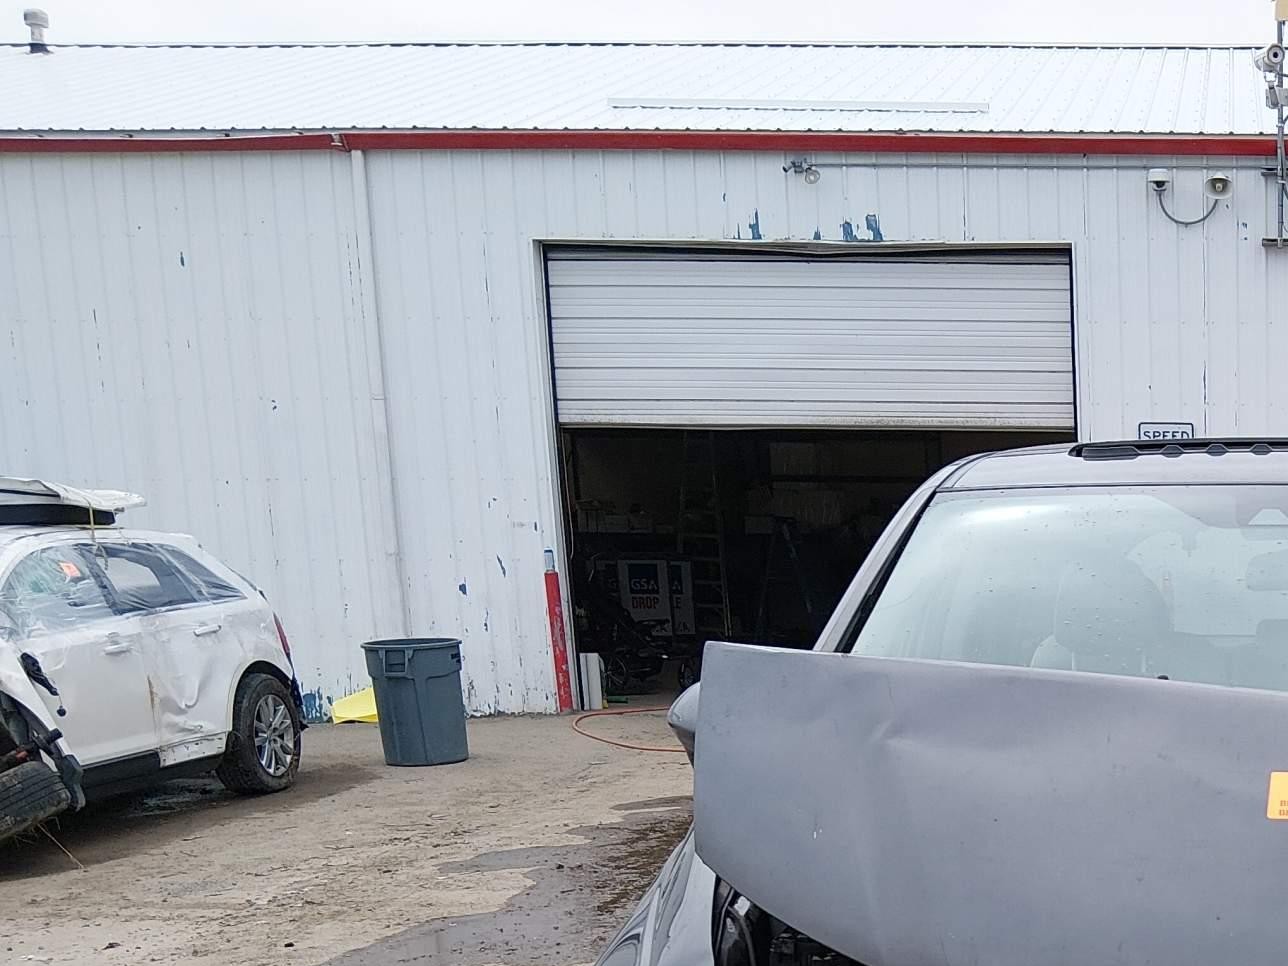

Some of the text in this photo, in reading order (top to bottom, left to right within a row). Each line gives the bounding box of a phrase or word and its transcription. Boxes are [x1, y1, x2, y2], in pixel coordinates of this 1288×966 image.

[1143, 430, 1190, 440] SPEED
[631, 578, 658, 590] GSA
[632, 596, 659, 609] DROP
